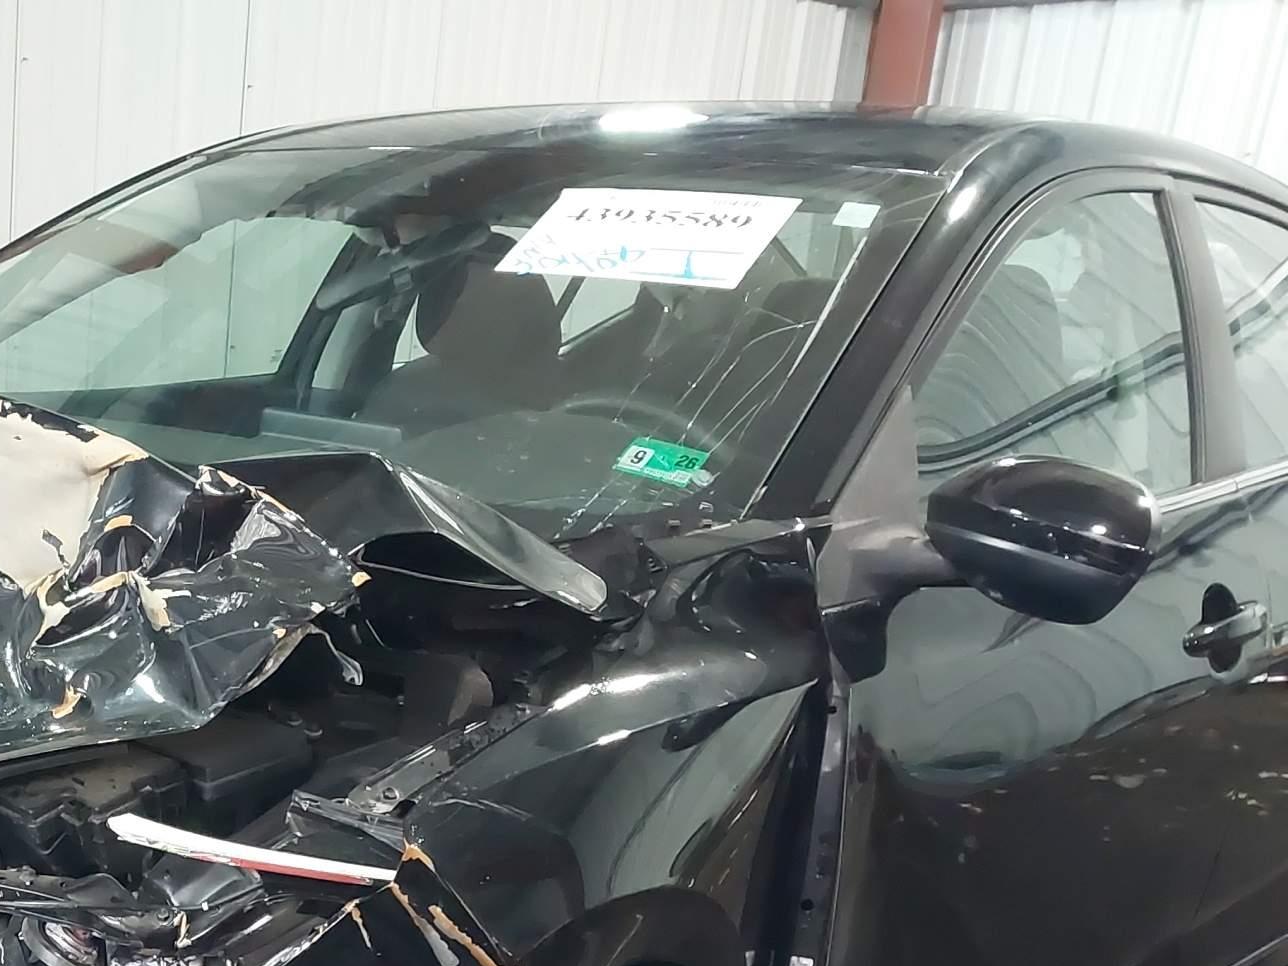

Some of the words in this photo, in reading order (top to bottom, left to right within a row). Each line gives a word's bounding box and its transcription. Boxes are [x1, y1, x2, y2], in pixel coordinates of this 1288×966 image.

[566, 207, 753, 230] 43935589
[630, 450, 647, 465] 9
[674, 454, 699, 469] 26
